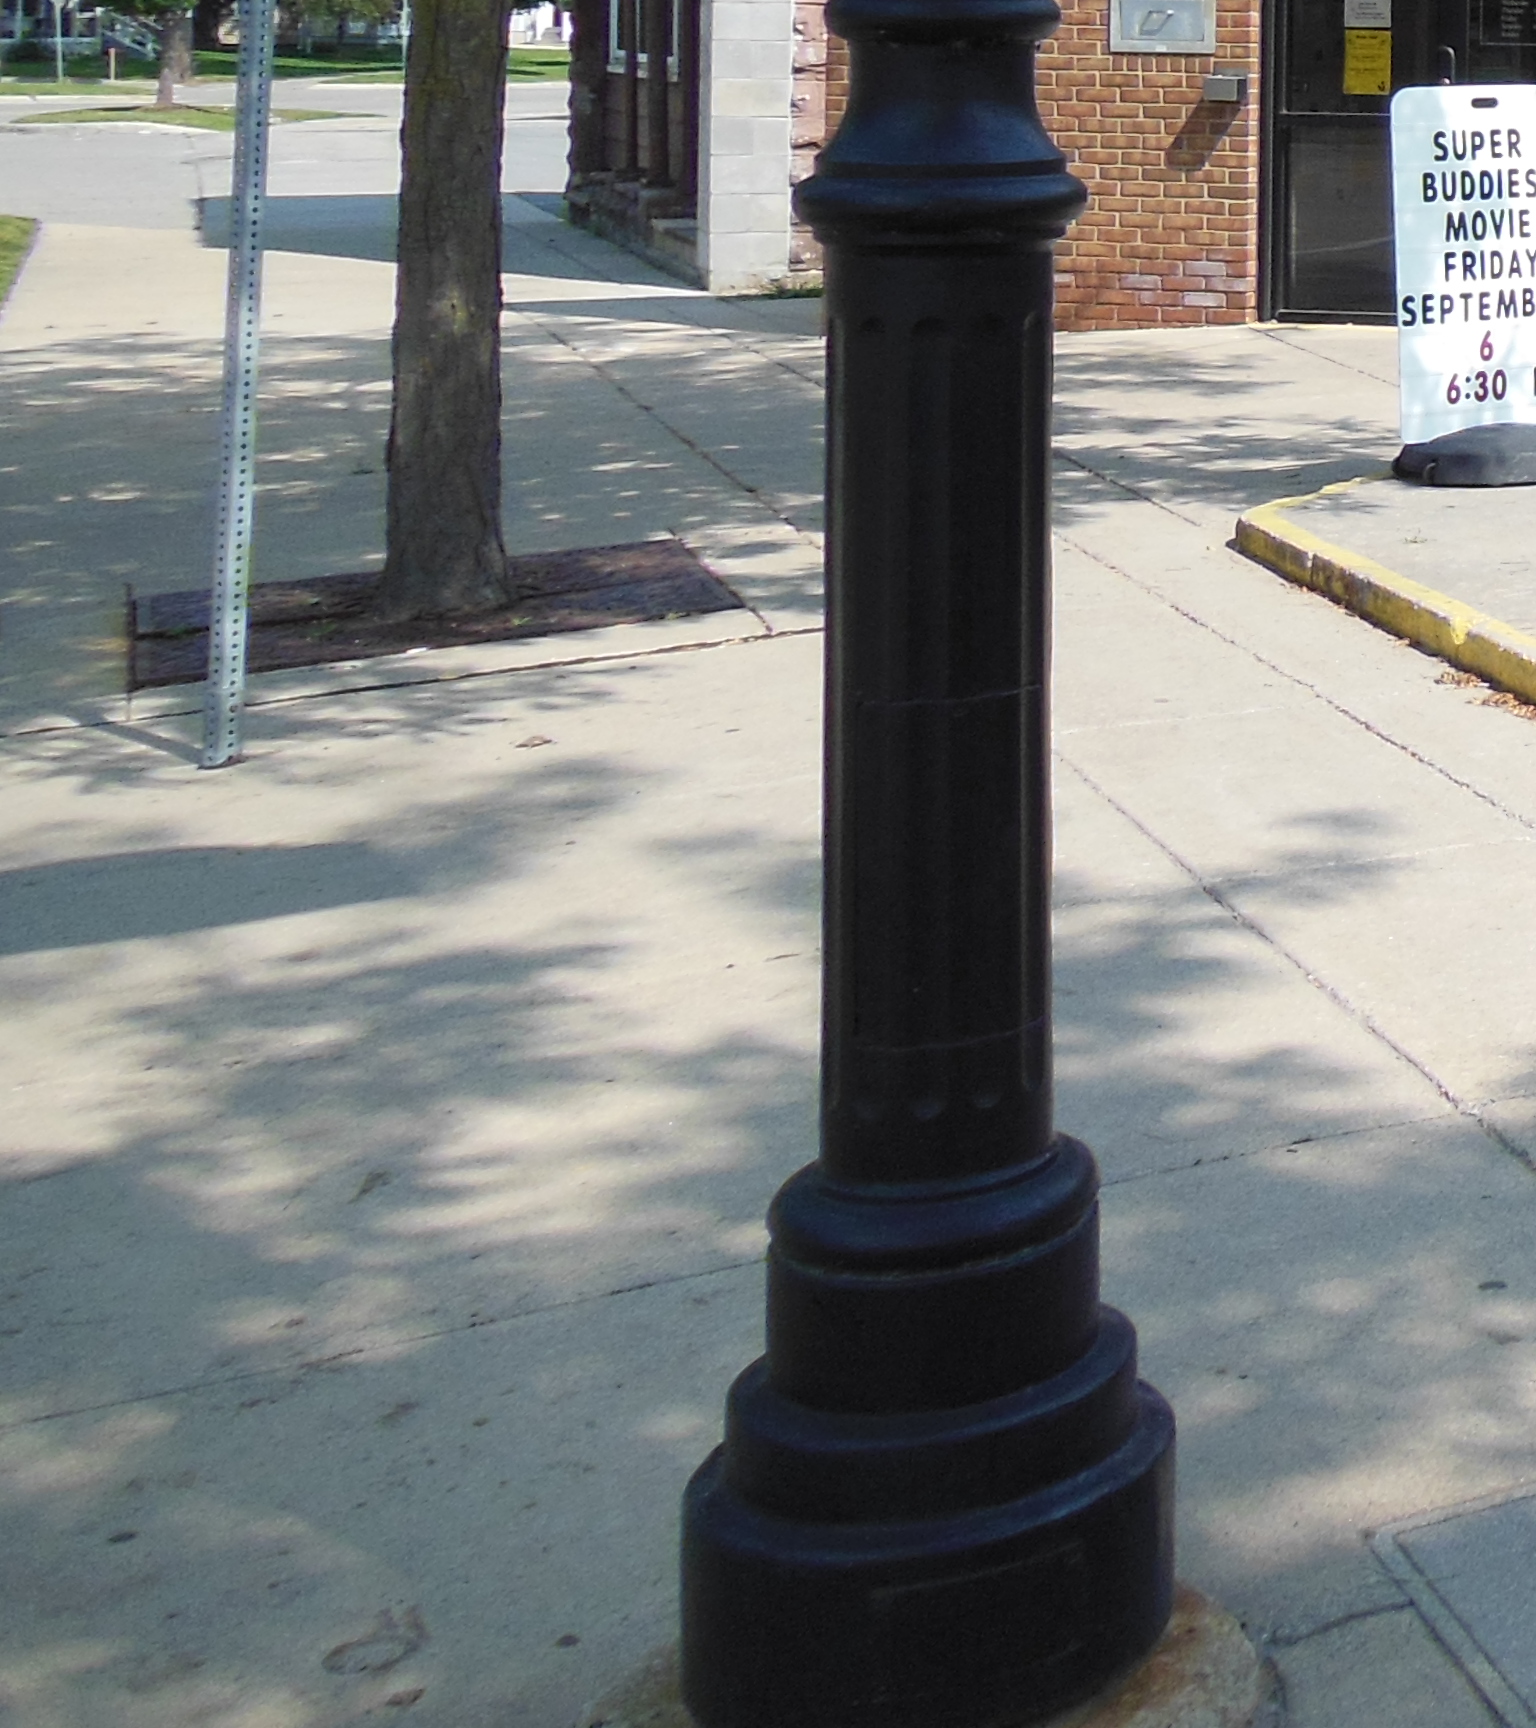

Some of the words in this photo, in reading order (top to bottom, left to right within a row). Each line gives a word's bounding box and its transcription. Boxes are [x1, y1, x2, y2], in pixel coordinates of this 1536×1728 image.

[1432, 128, 1522, 163] SUPER
[1444, 208, 1532, 242] MOVIE
[1479, 330, 1494, 362] 6
[1446, 369, 1508, 405] 6:30
